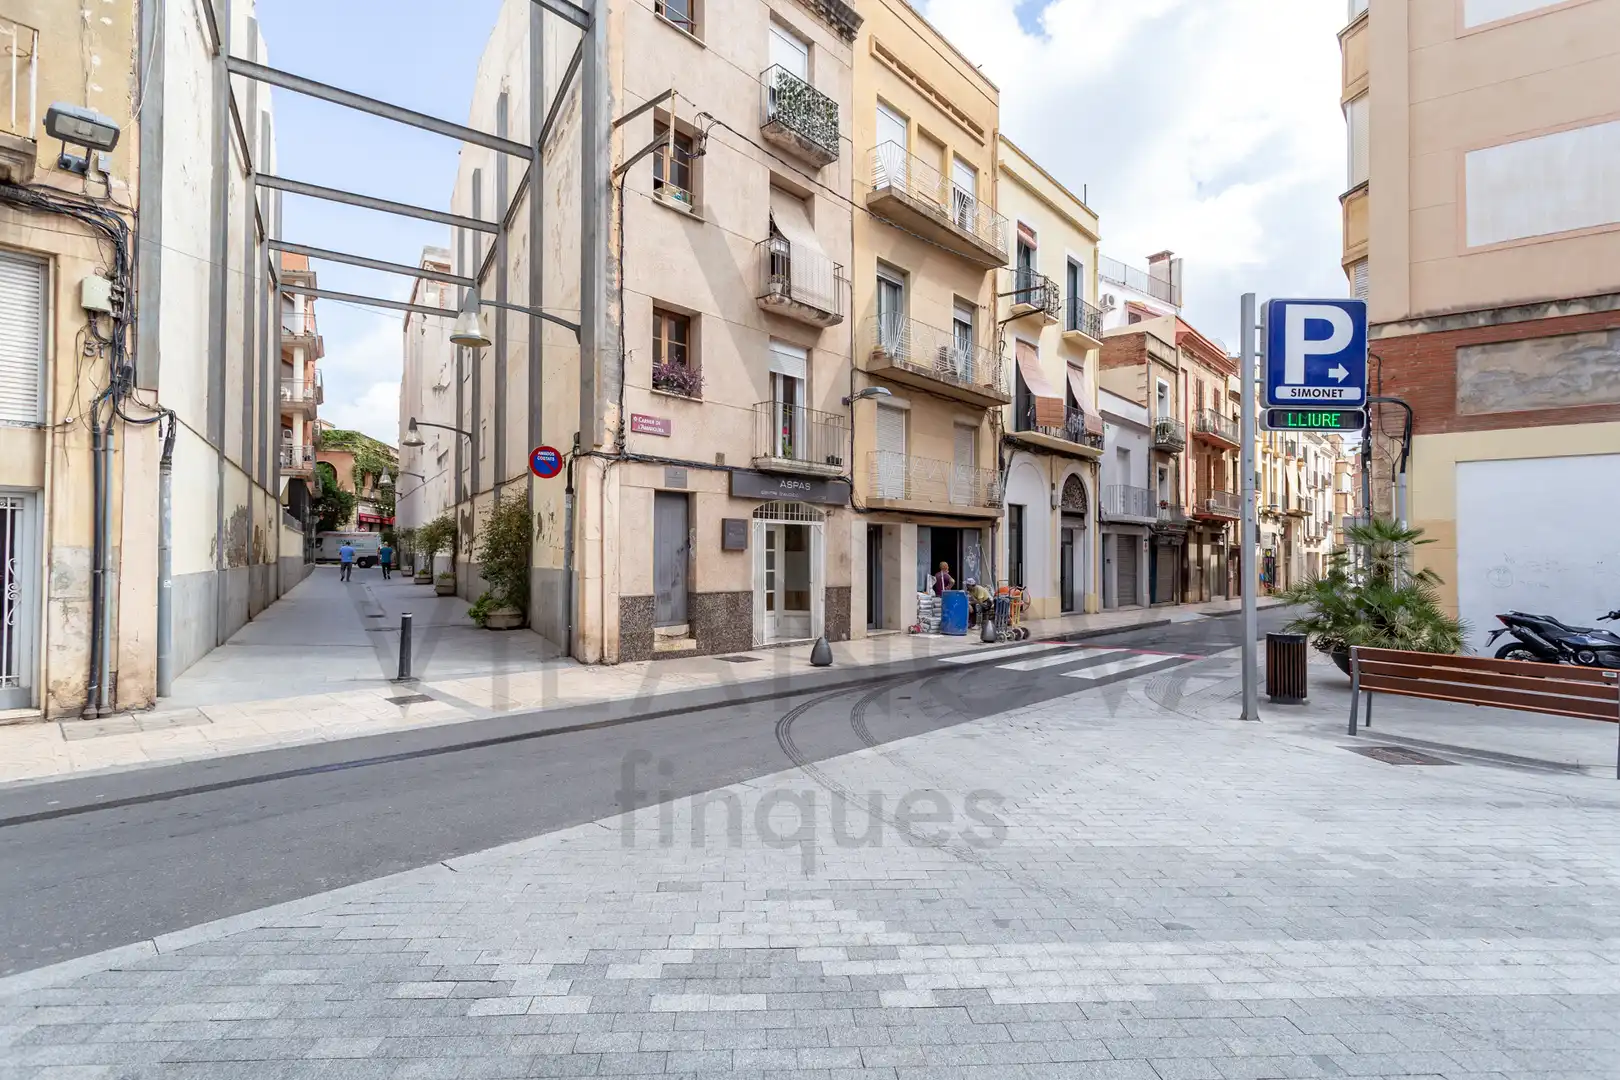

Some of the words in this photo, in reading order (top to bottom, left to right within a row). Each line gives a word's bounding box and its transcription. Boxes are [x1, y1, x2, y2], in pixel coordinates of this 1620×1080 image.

[1284, 303, 1354, 385] P
[1290, 388, 1344, 398] SIMONET
[1288, 412, 1341, 427] LLIURE
[779, 480, 811, 491] ASPAS
